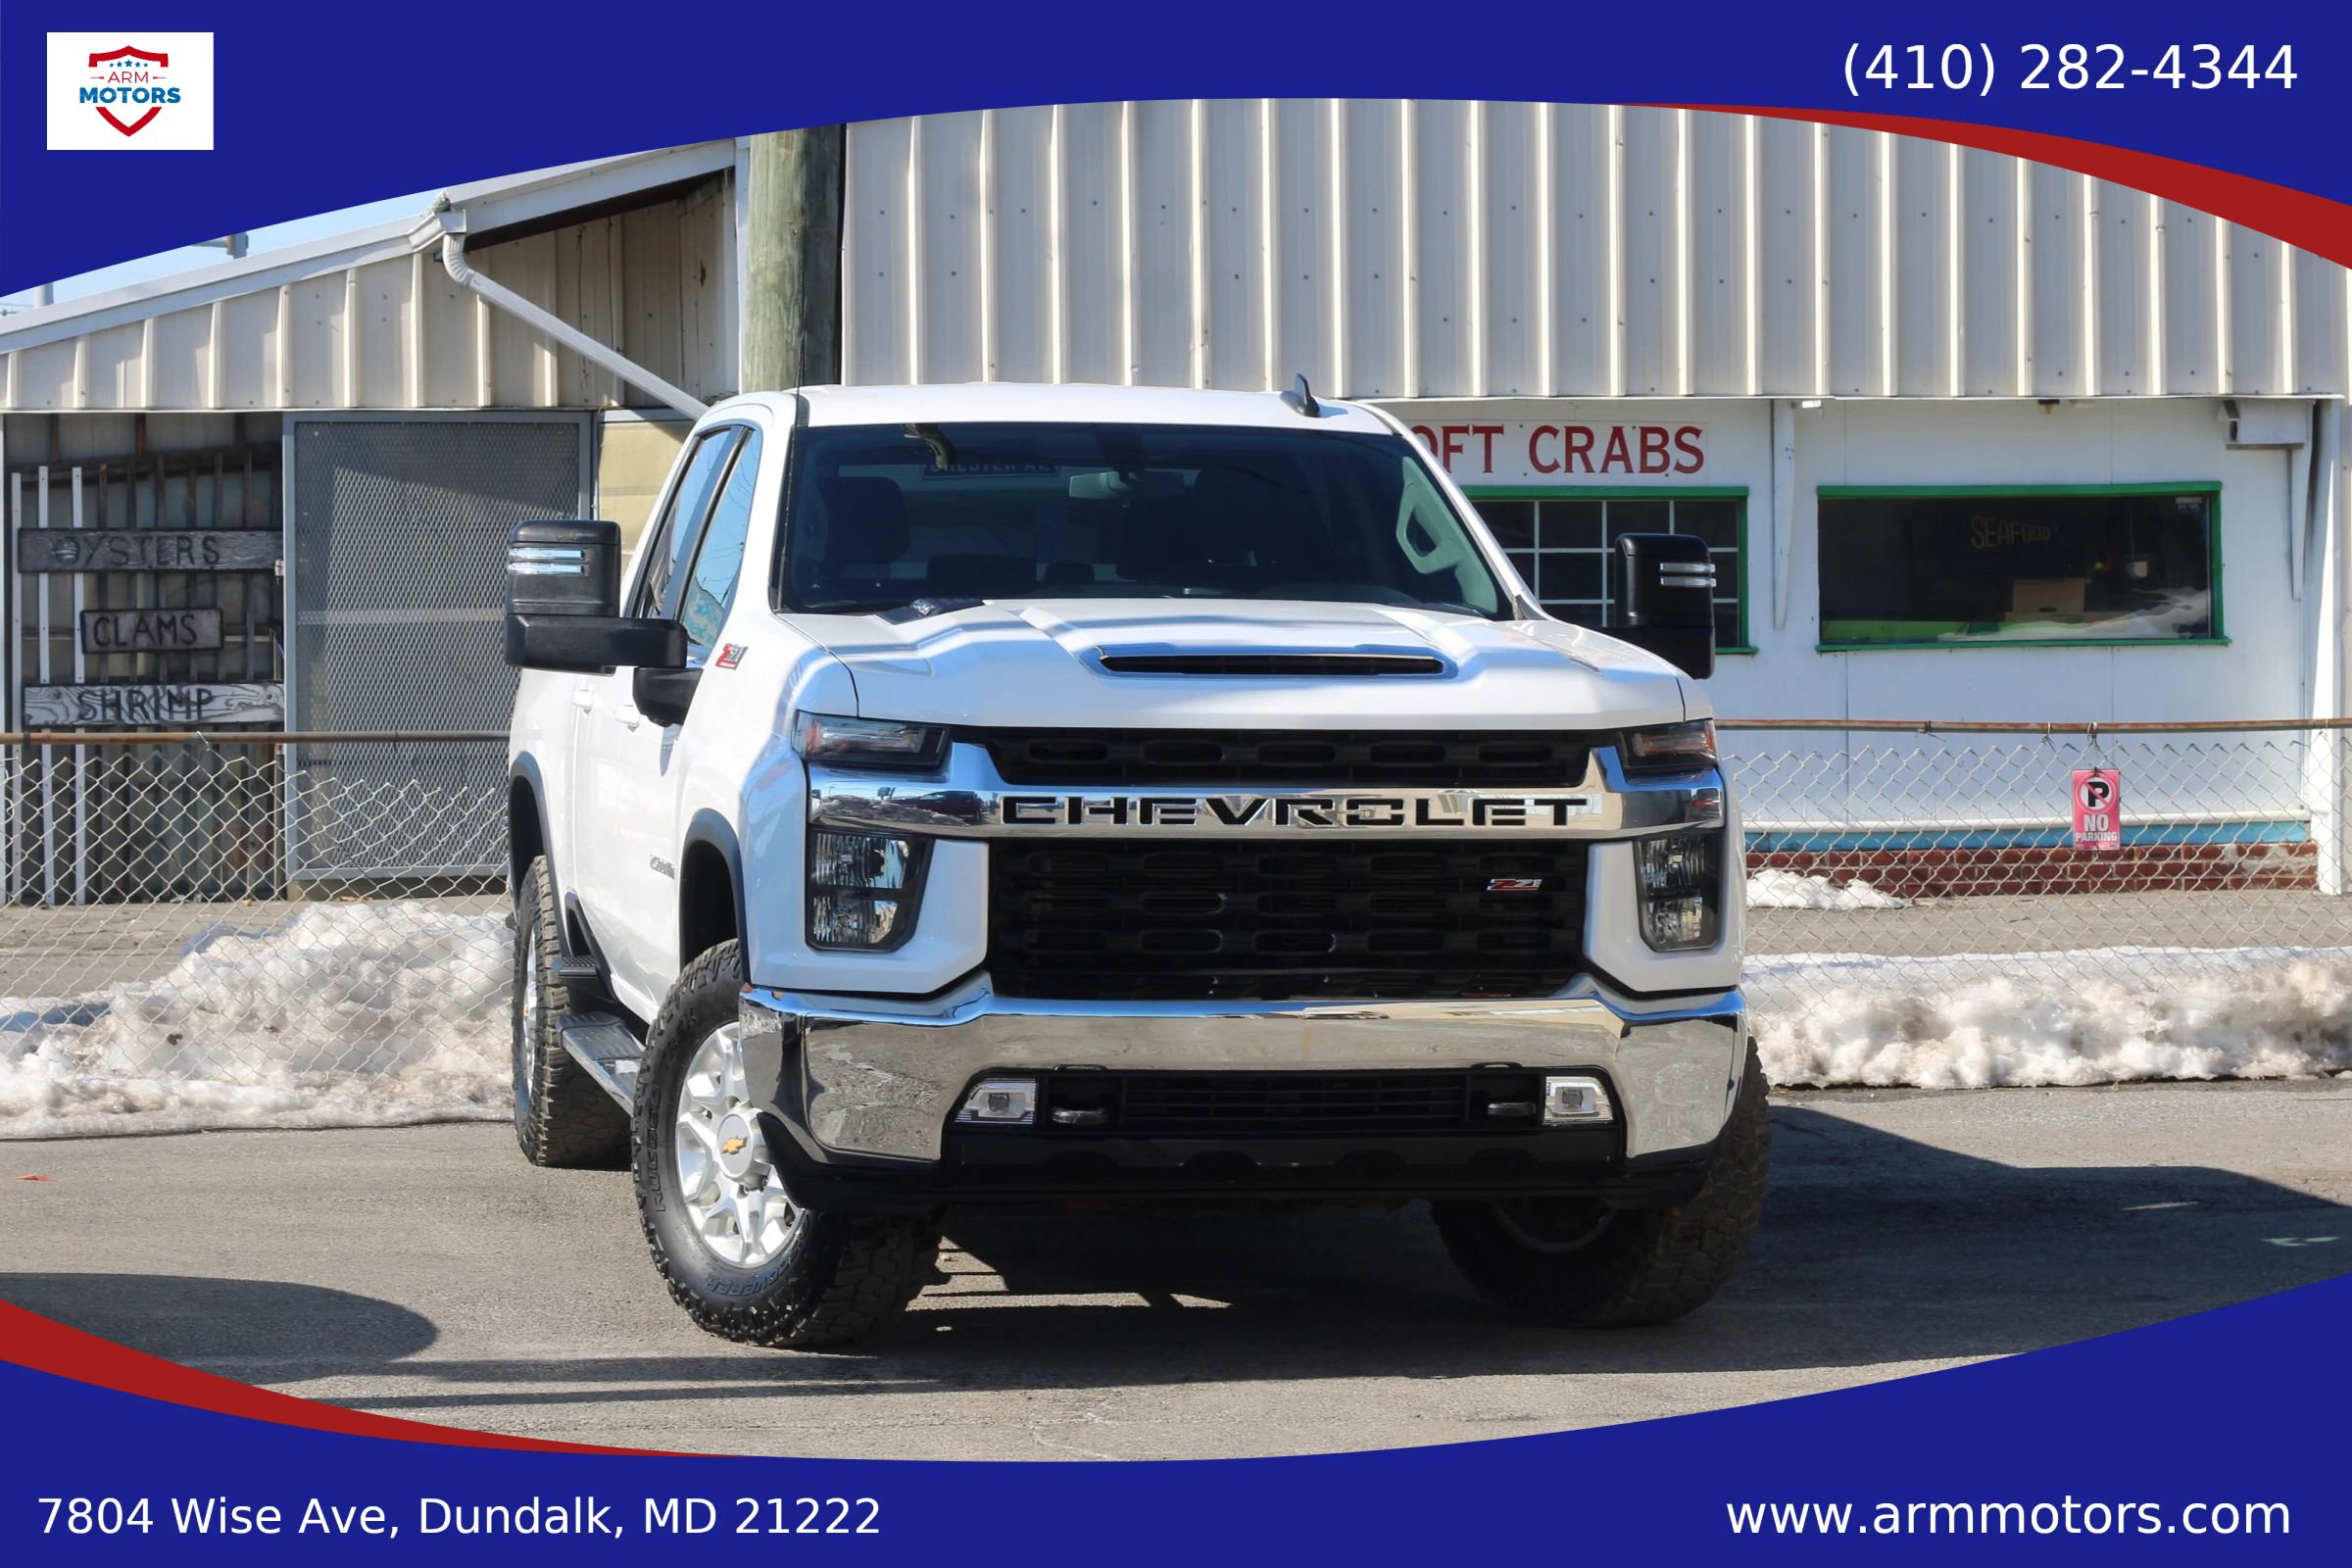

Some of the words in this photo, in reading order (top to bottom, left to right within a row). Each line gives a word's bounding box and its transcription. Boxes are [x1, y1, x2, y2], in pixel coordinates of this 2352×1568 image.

[1529, 425, 1704, 474] CRABS
[54, 535, 220, 565] OYSTERS
[93, 613, 197, 647] CLAMS
[77, 688, 214, 722] SHRIMP
[1001, 795, 1588, 828] CHEVROLET
[2083, 813, 2109, 832] NO
[2075, 831, 2118, 842] PARKING
